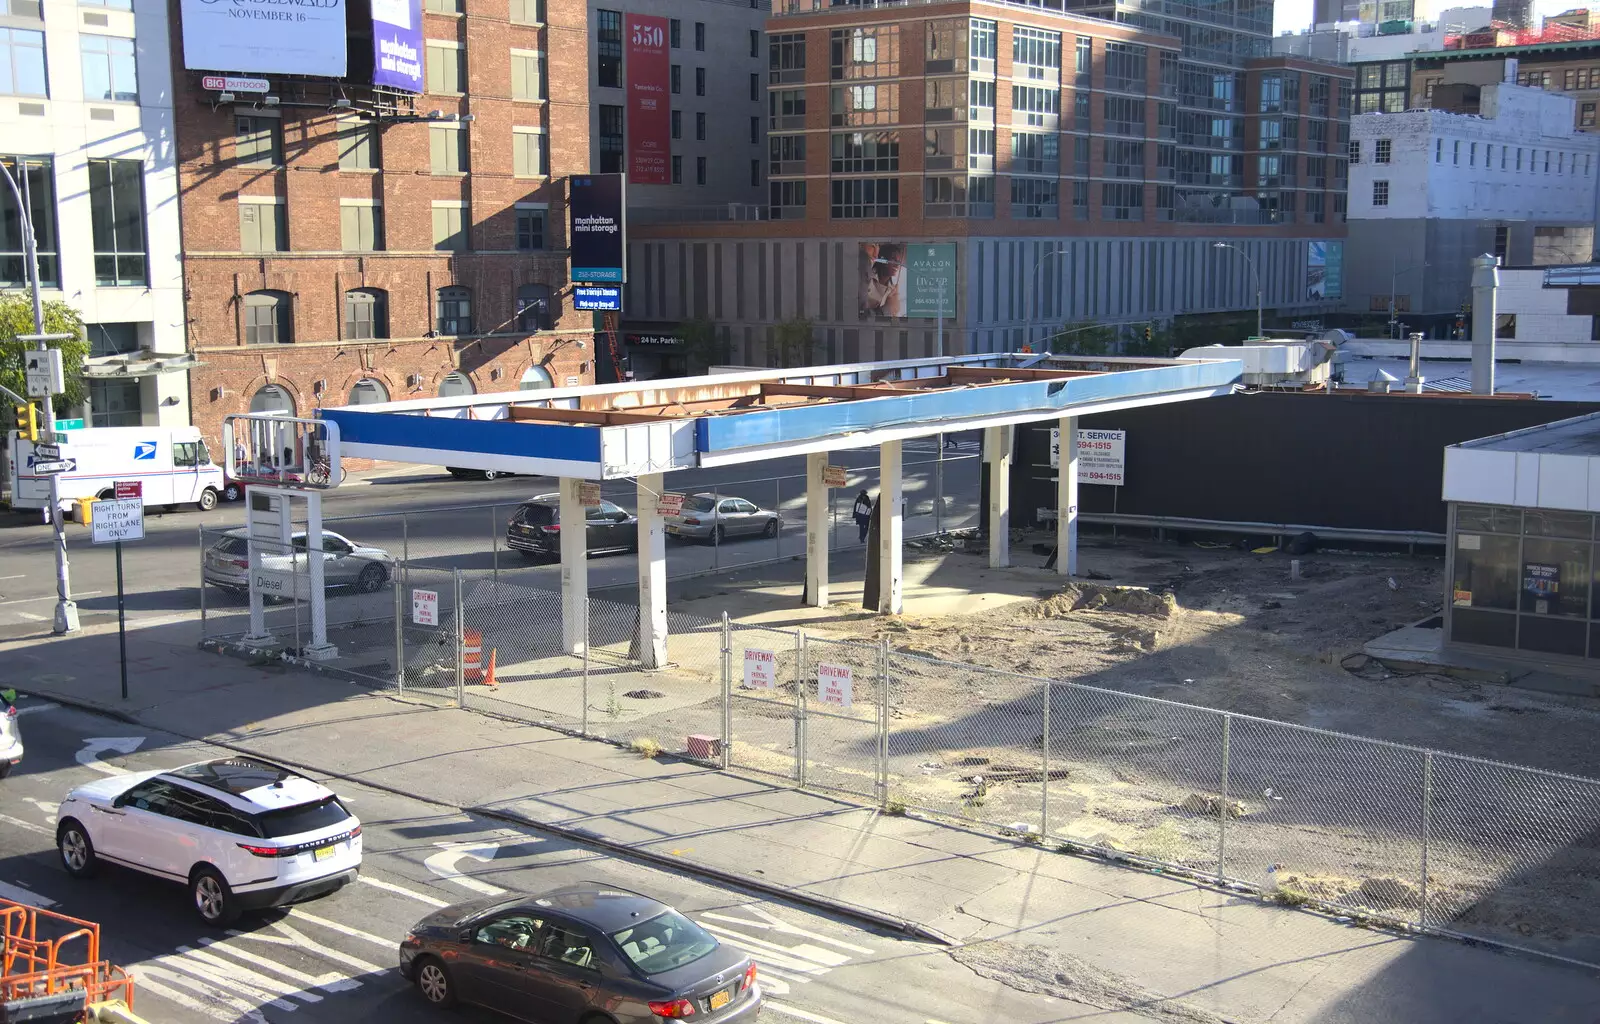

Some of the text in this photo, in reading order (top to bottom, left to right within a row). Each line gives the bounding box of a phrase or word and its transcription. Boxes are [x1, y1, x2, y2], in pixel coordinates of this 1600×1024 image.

[228, 8, 306, 22] NOVEMBER 16
[632, 24, 663, 47] 550
[206, 78, 266, 90] BIG OUTDOOR
[575, 214, 614, 224] manhattan
[591, 224, 618, 234] storage
[1087, 432, 1122, 440] SERVICE
[1077, 441, 1112, 450] 594-1515
[1089, 472, 1122, 480] 594-1515
[257, 576, 282, 590] Diesel
[414, 592, 436, 602] DRIVEWAY
[745, 650, 773, 662] DRIVEWAY
[820, 665, 849, 678] DRIVEWAY
[826, 687, 842, 696] PARKING
[826, 696, 842, 704] ANYTIME
[299, 832, 350, 849] RANGE ROVER
